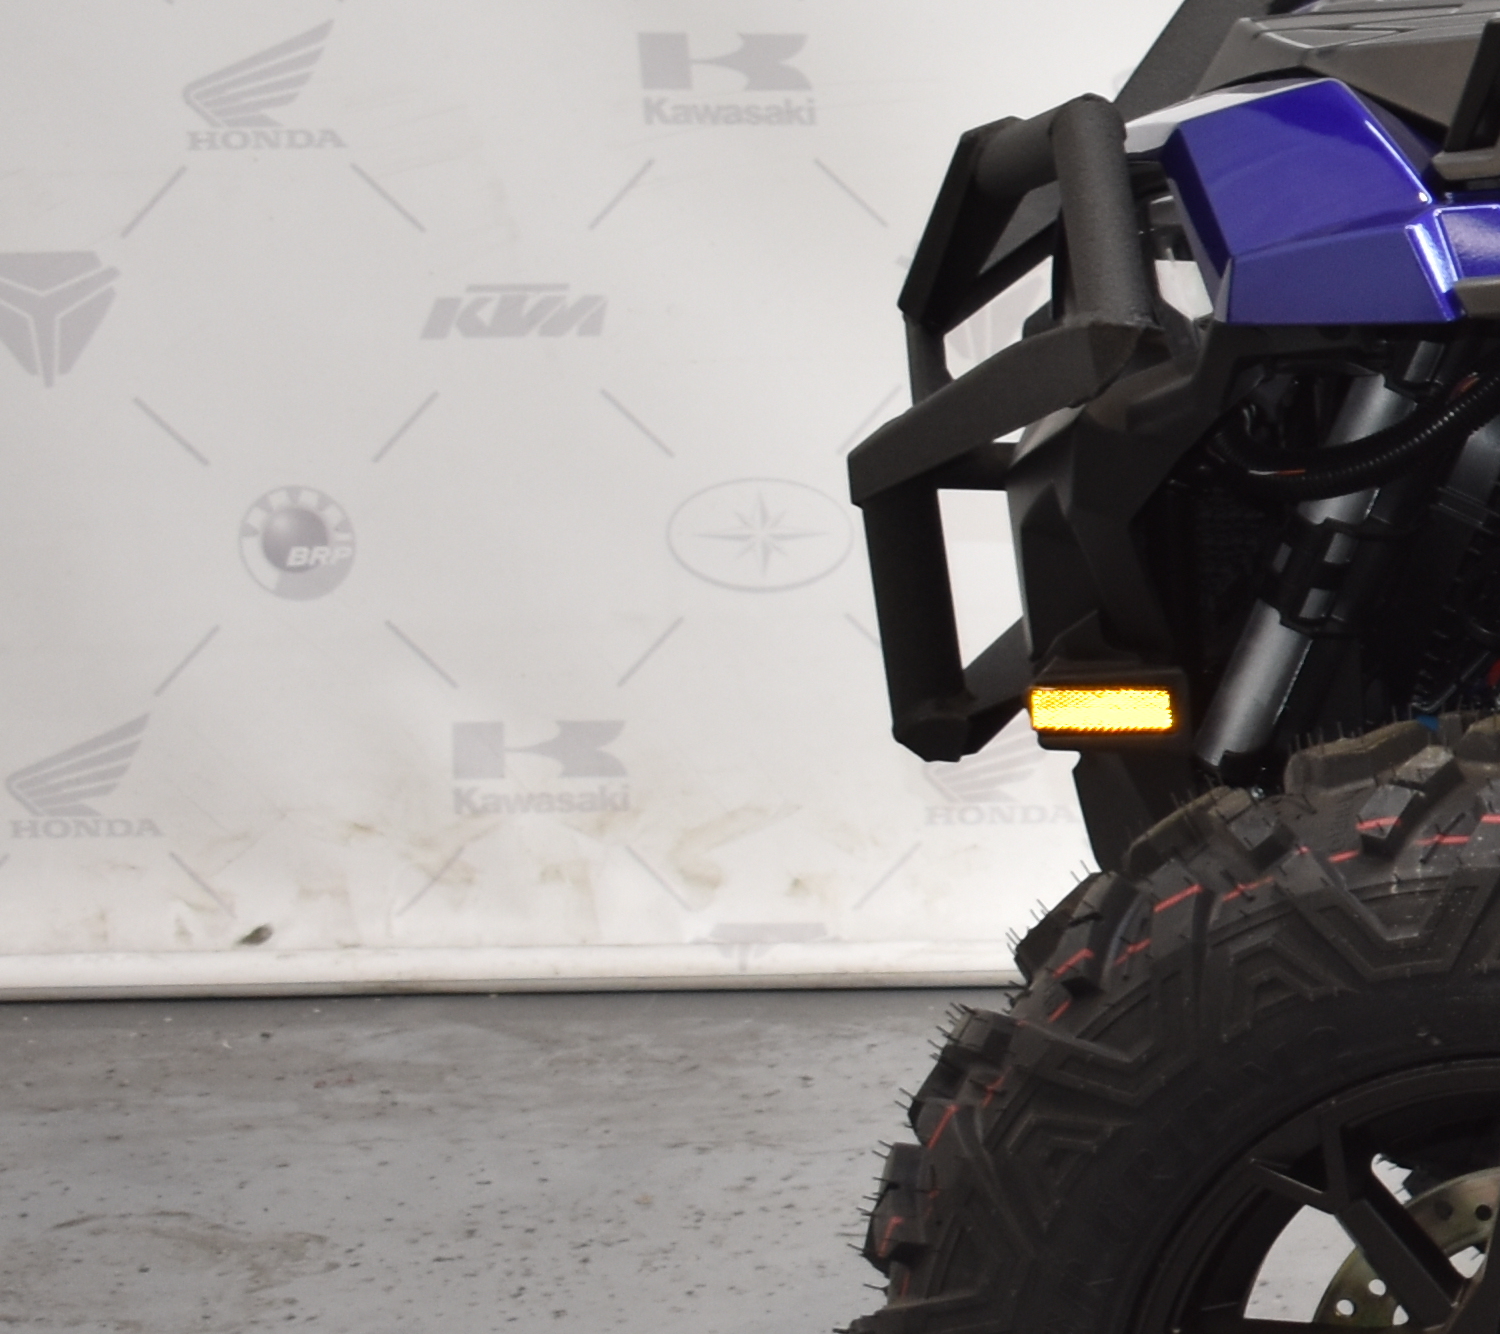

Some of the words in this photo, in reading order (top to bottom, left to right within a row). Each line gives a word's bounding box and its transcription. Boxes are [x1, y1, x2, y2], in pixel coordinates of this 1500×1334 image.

[645, 95, 815, 127] Kawasaki
[188, 127, 347, 150] HONDA
[420, 283, 606, 340] KTM
[287, 544, 350, 567] BRP
[450, 785, 630, 815] Kawasaki
[925, 805, 1077, 827] HONDA
[8, 817, 163, 839] HONDA
